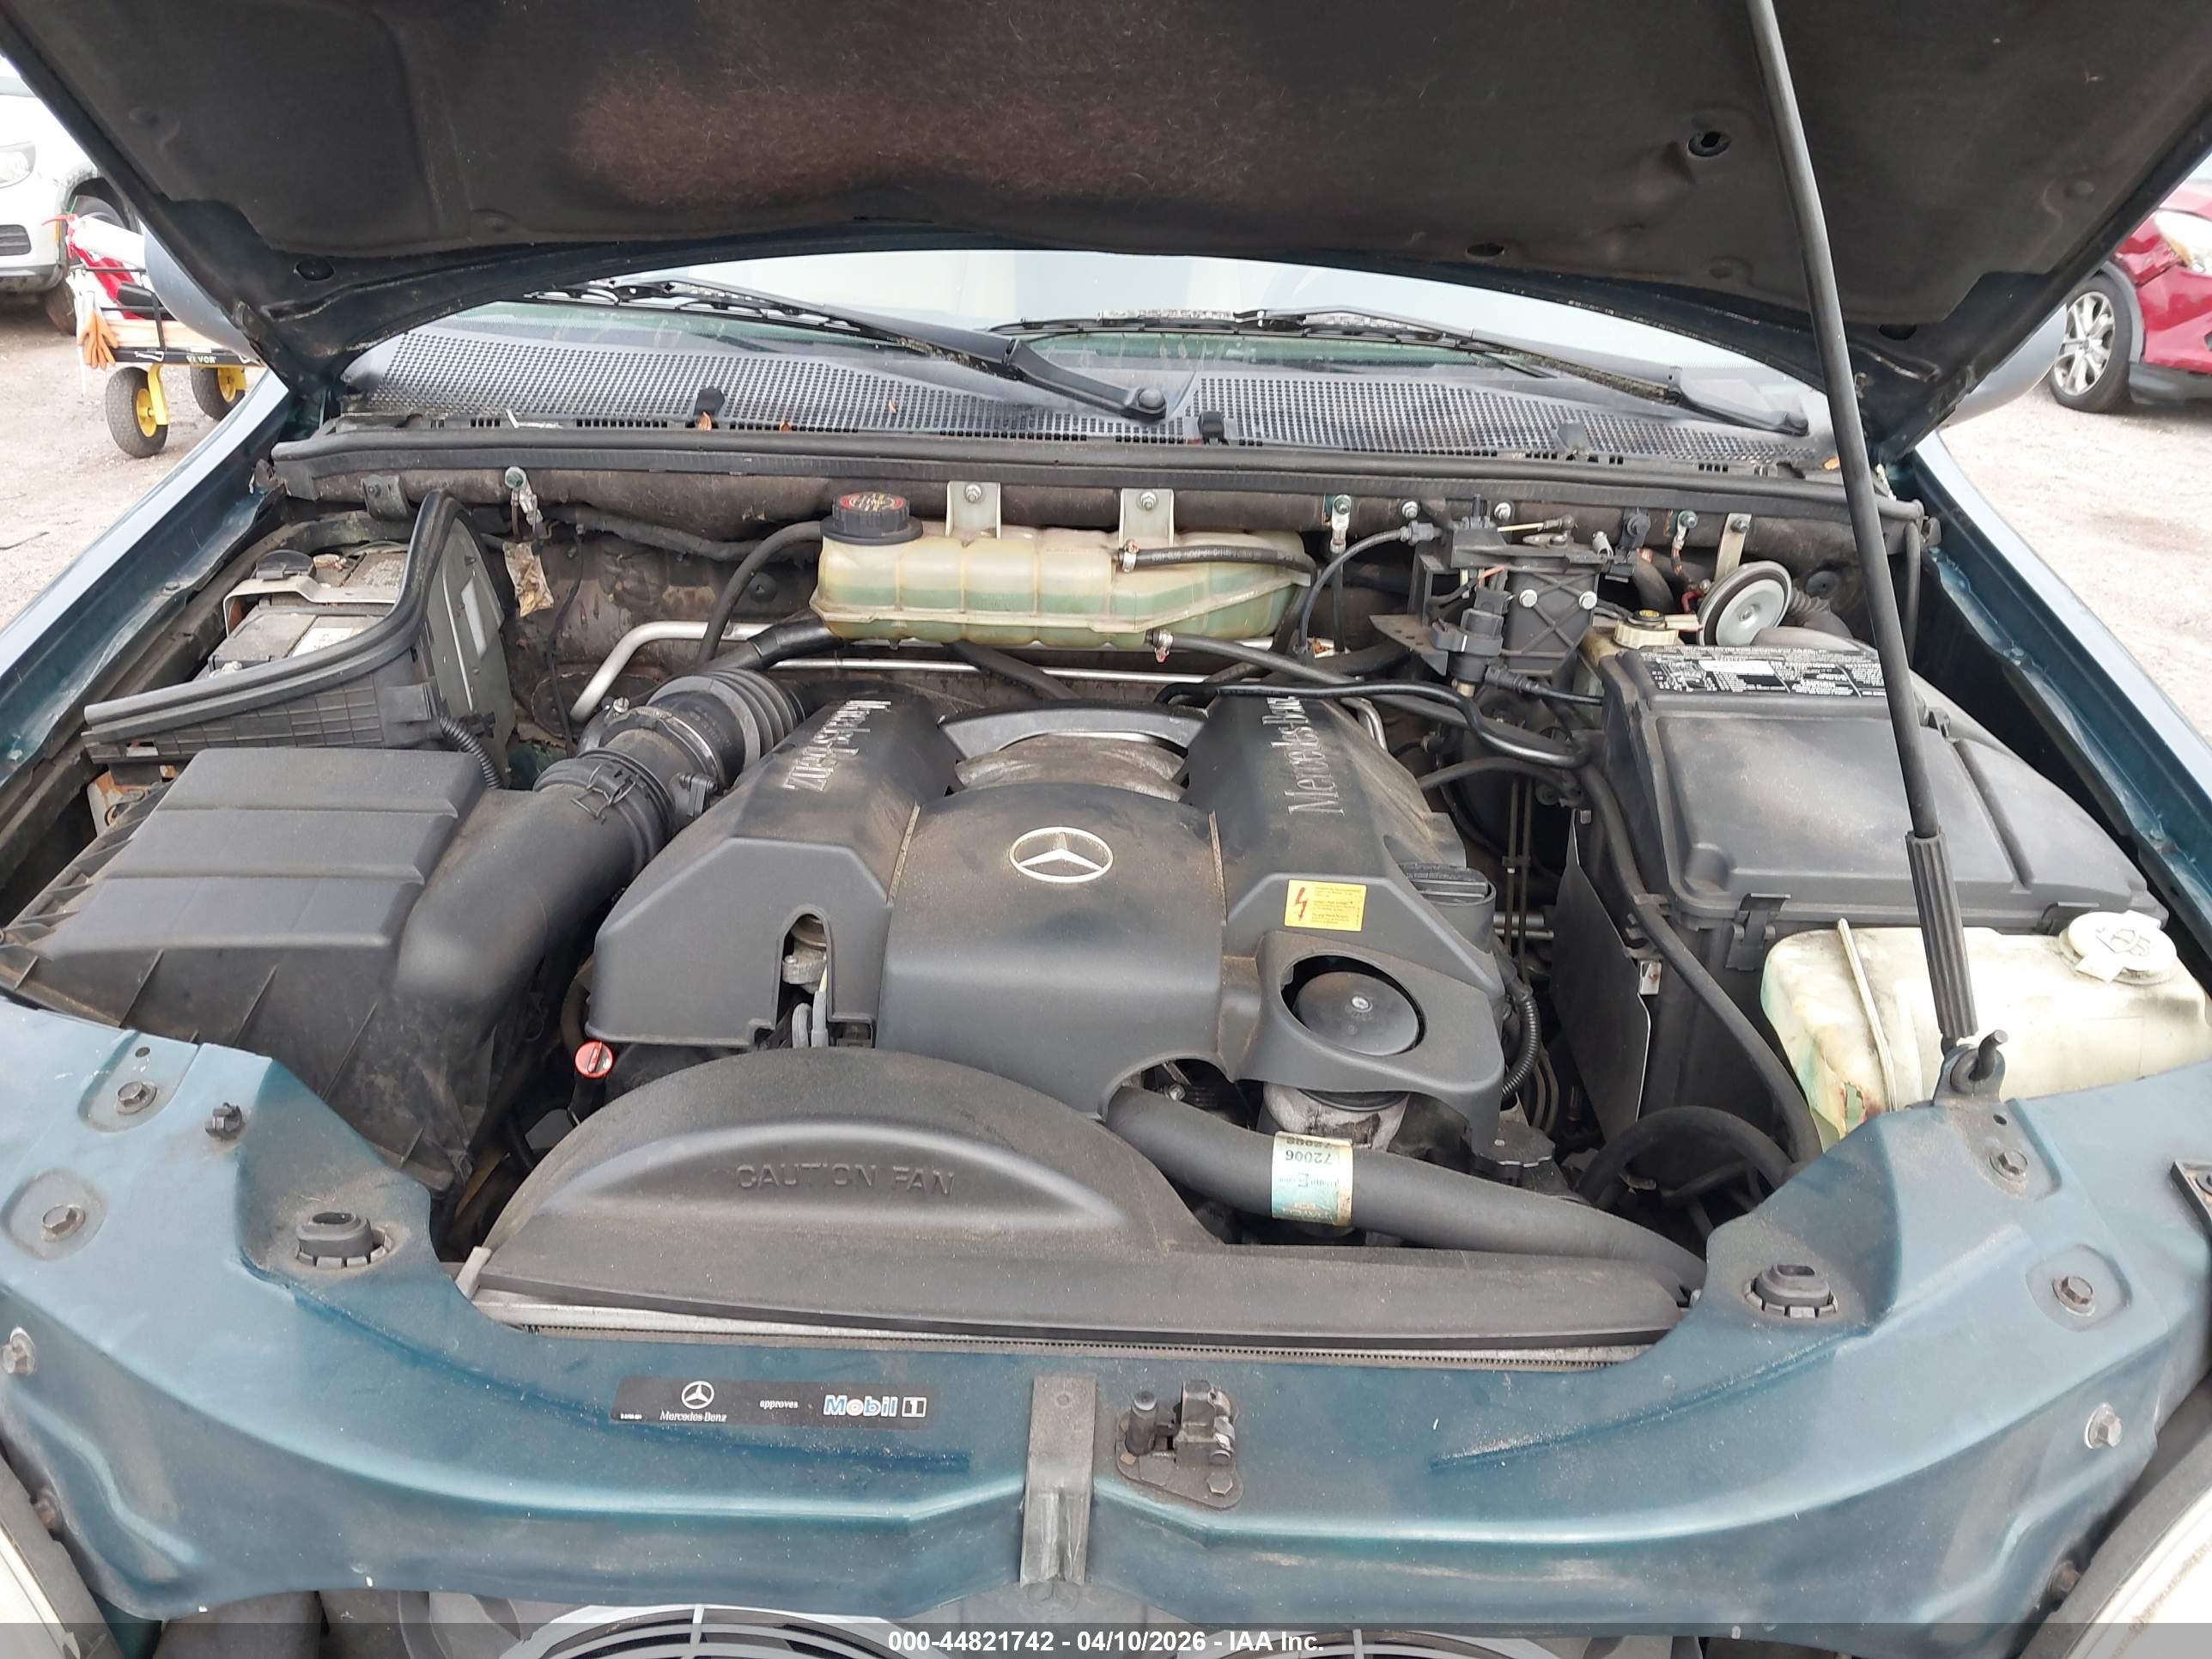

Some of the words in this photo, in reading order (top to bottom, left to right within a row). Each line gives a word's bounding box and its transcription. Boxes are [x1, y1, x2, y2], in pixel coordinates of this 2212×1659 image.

[1285, 1149, 1333, 1165] 72006
[737, 1162, 877, 1188] CAUTION
[893, 1164, 956, 1195] FAN
[760, 1400, 798, 1409] approves
[823, 1395, 898, 1417] Mobil
